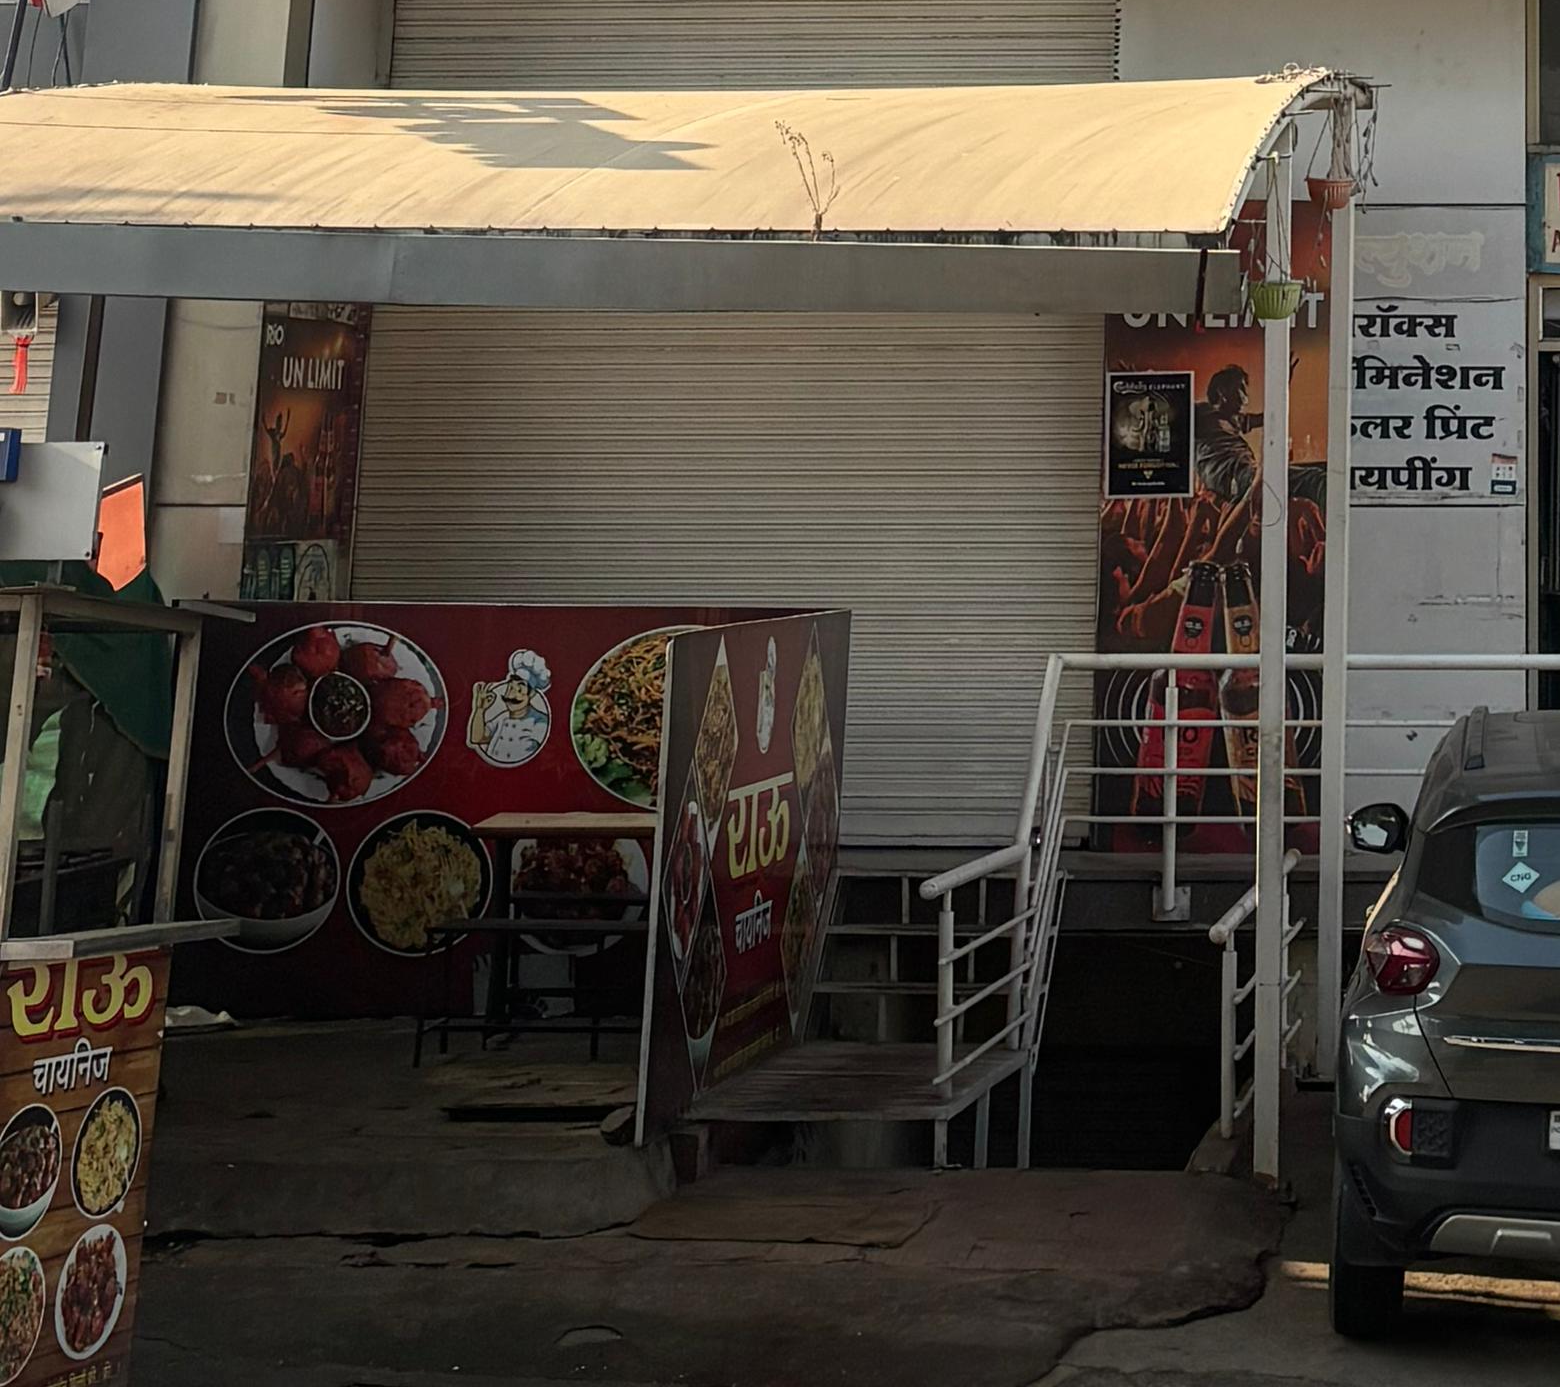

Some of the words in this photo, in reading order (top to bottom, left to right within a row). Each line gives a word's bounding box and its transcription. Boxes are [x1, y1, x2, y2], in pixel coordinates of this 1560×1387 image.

[1353, 305, 1458, 338] रॉक्स
[282, 356, 304, 388] UN
[307, 357, 345, 390] LIMIT
[1352, 354, 1506, 390] मिनेशन
[1423, 404, 1496, 441] प्रिंट
[727, 771, 794, 879] राऊ
[33, 1037, 113, 1096] चायनिज
